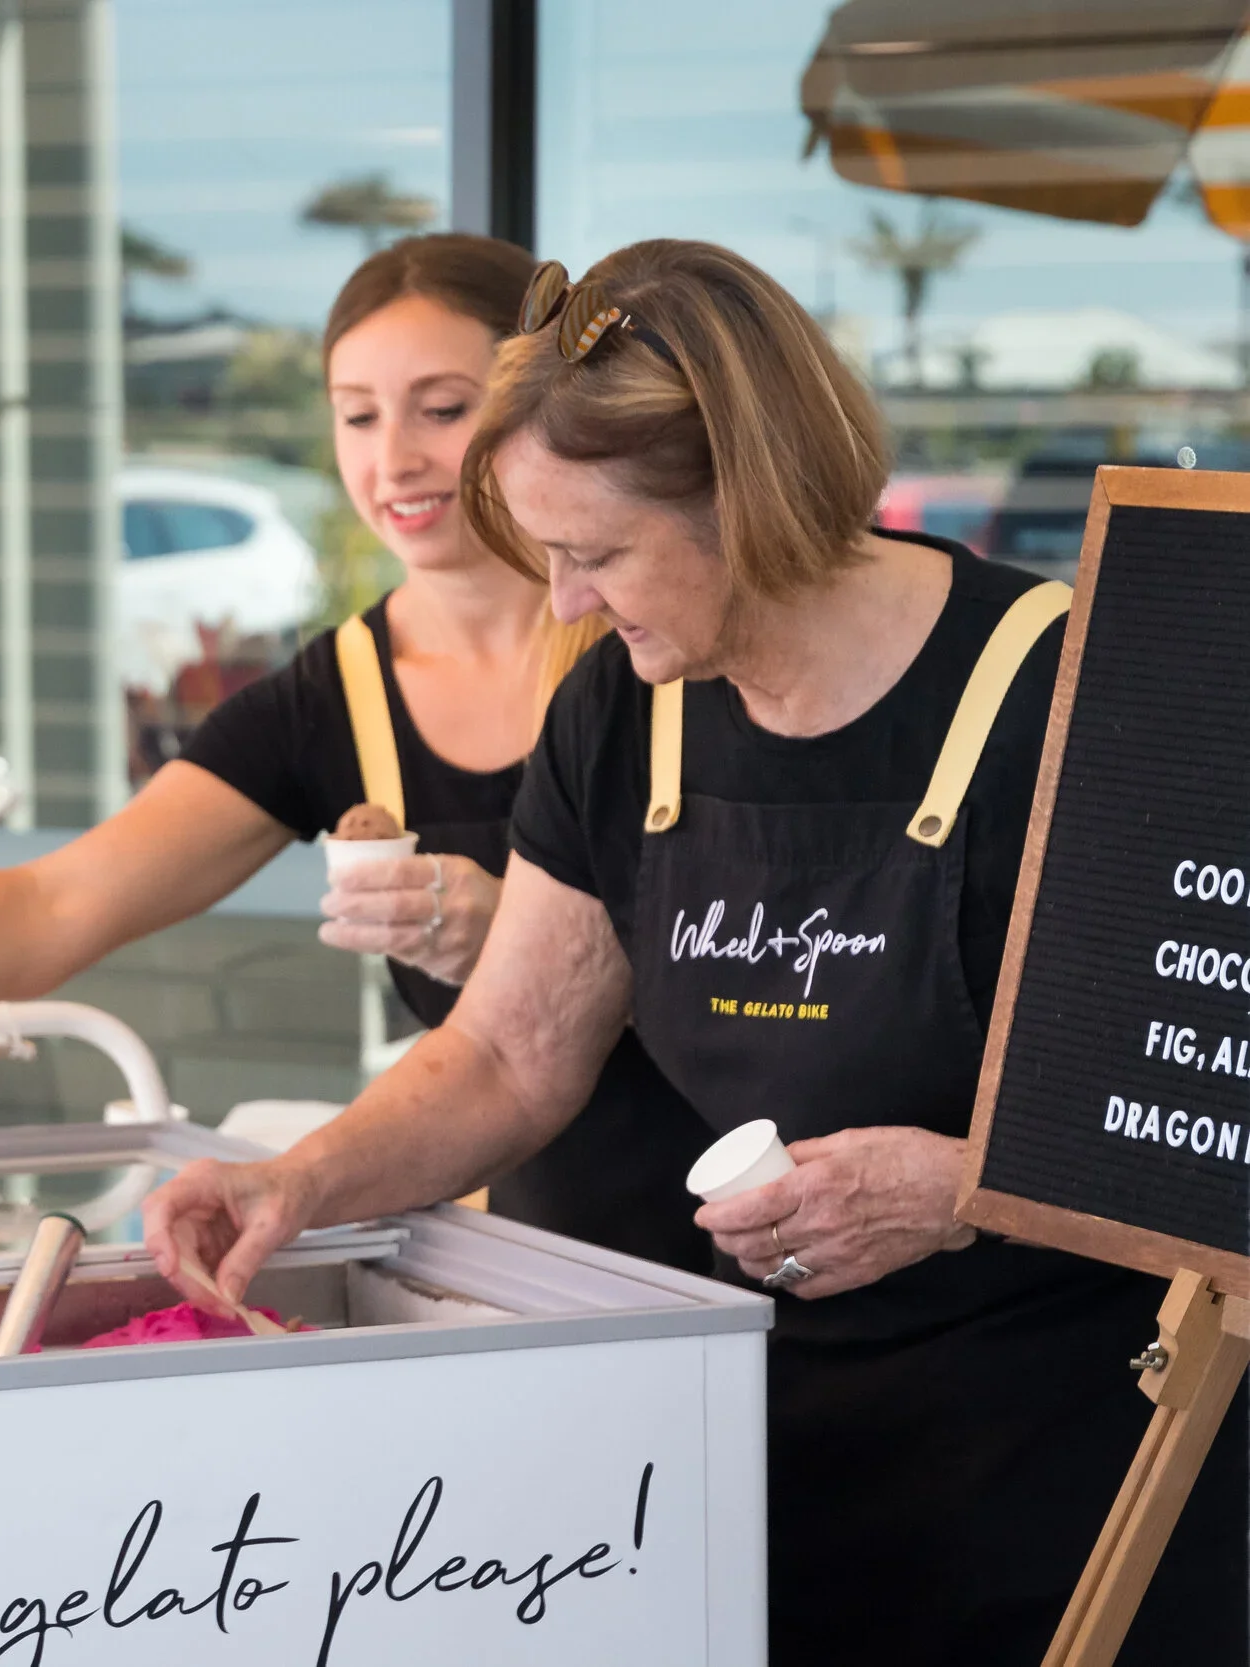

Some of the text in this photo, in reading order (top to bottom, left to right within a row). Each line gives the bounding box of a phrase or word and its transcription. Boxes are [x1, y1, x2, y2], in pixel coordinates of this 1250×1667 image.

[1173, 859, 1250, 907] COO
[710, 997, 830, 1020] THE GELATO BIKE
[1145, 1020, 1250, 1079] FIG, AL
[316, 1461, 654, 1667] please!
